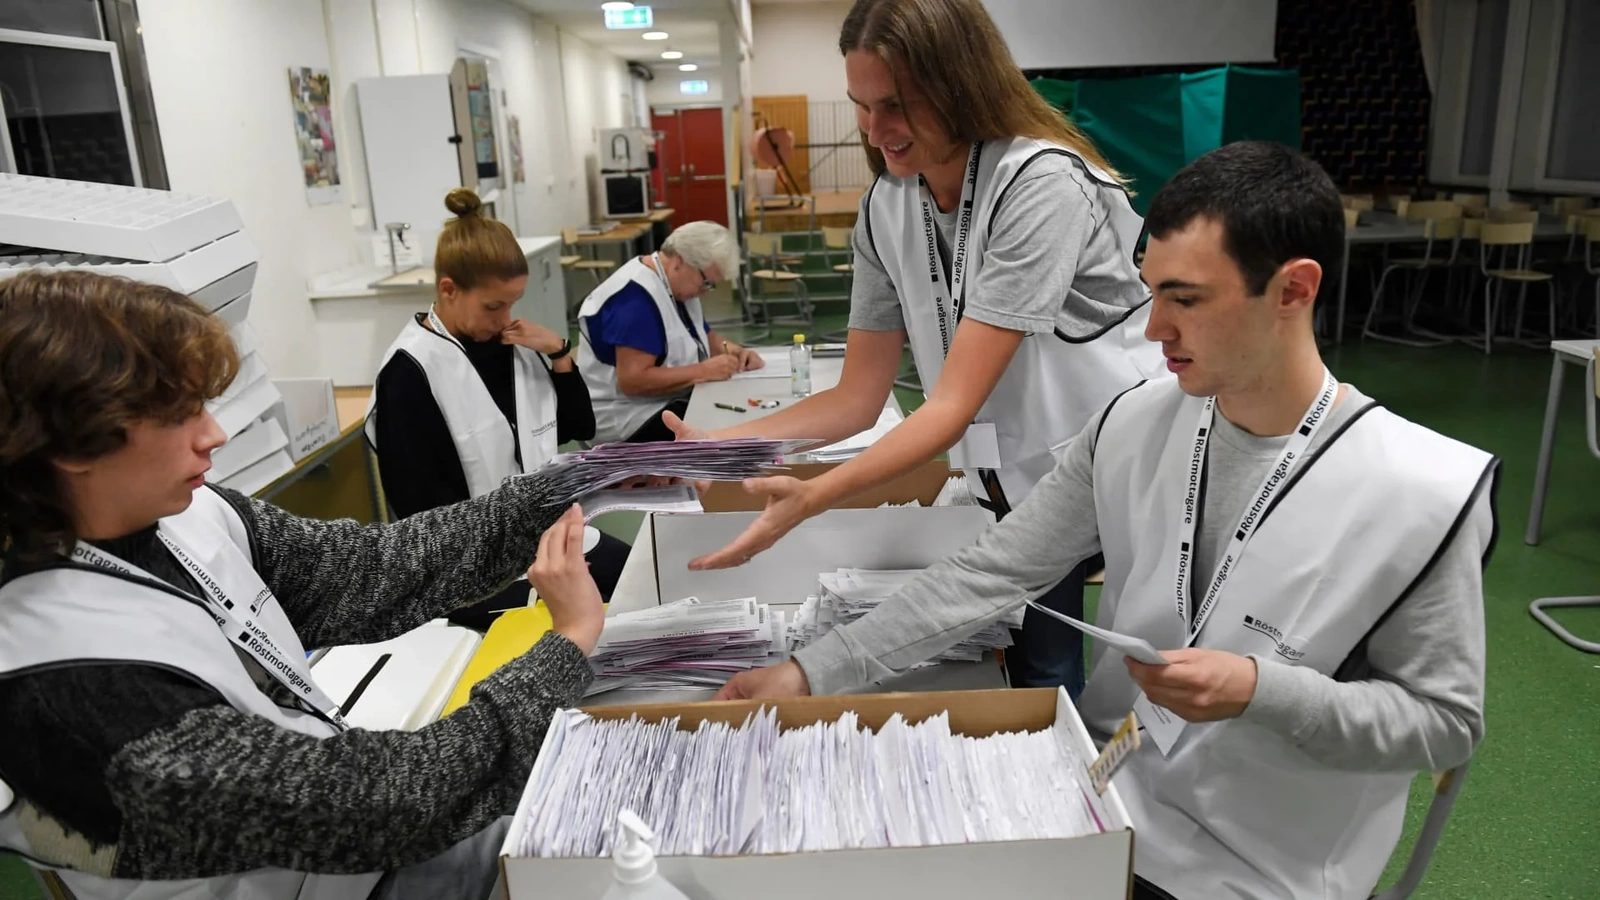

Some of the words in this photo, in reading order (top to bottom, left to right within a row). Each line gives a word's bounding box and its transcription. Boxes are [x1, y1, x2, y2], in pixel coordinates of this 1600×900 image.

[1185, 438, 1205, 524] Röstmottagare
[1241, 451, 1296, 532] Röstmottagare
[1195, 555, 1234, 627] Röstmottagare
[248, 638, 312, 694] Röstmottagare
